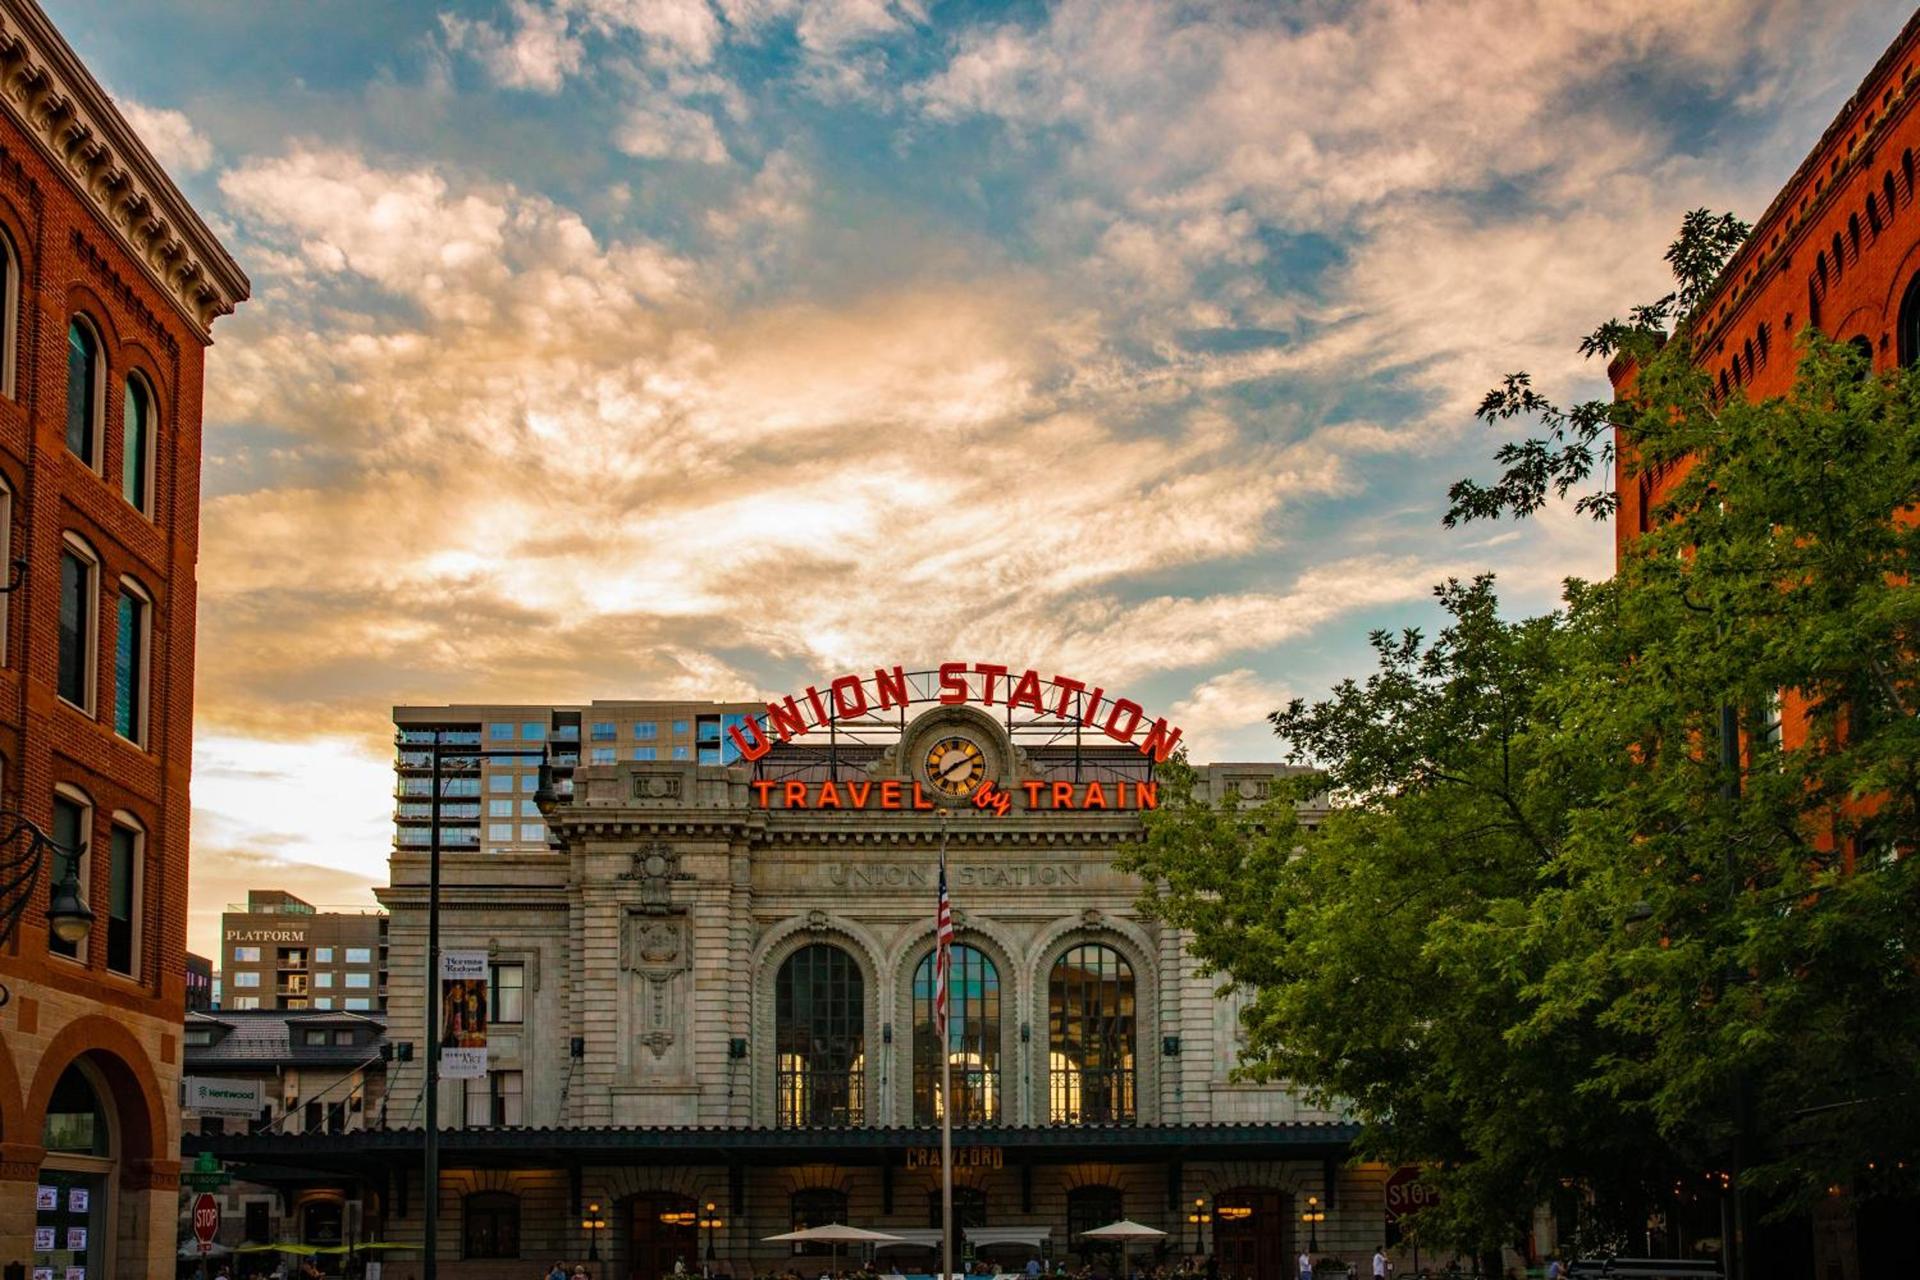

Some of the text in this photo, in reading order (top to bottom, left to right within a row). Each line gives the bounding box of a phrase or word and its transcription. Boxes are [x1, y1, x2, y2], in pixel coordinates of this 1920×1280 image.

[727, 662, 1183, 764] UNION STATION
[753, 779, 1159, 816] TRAVEL by TRAIN
[829, 863, 1081, 887] UNION STATION
[226, 930, 305, 942] PLATFORM
[208, 1088, 255, 1099] Kentwood
[1389, 1183, 1438, 1206] STOP
[196, 1208, 216, 1228] STOP
